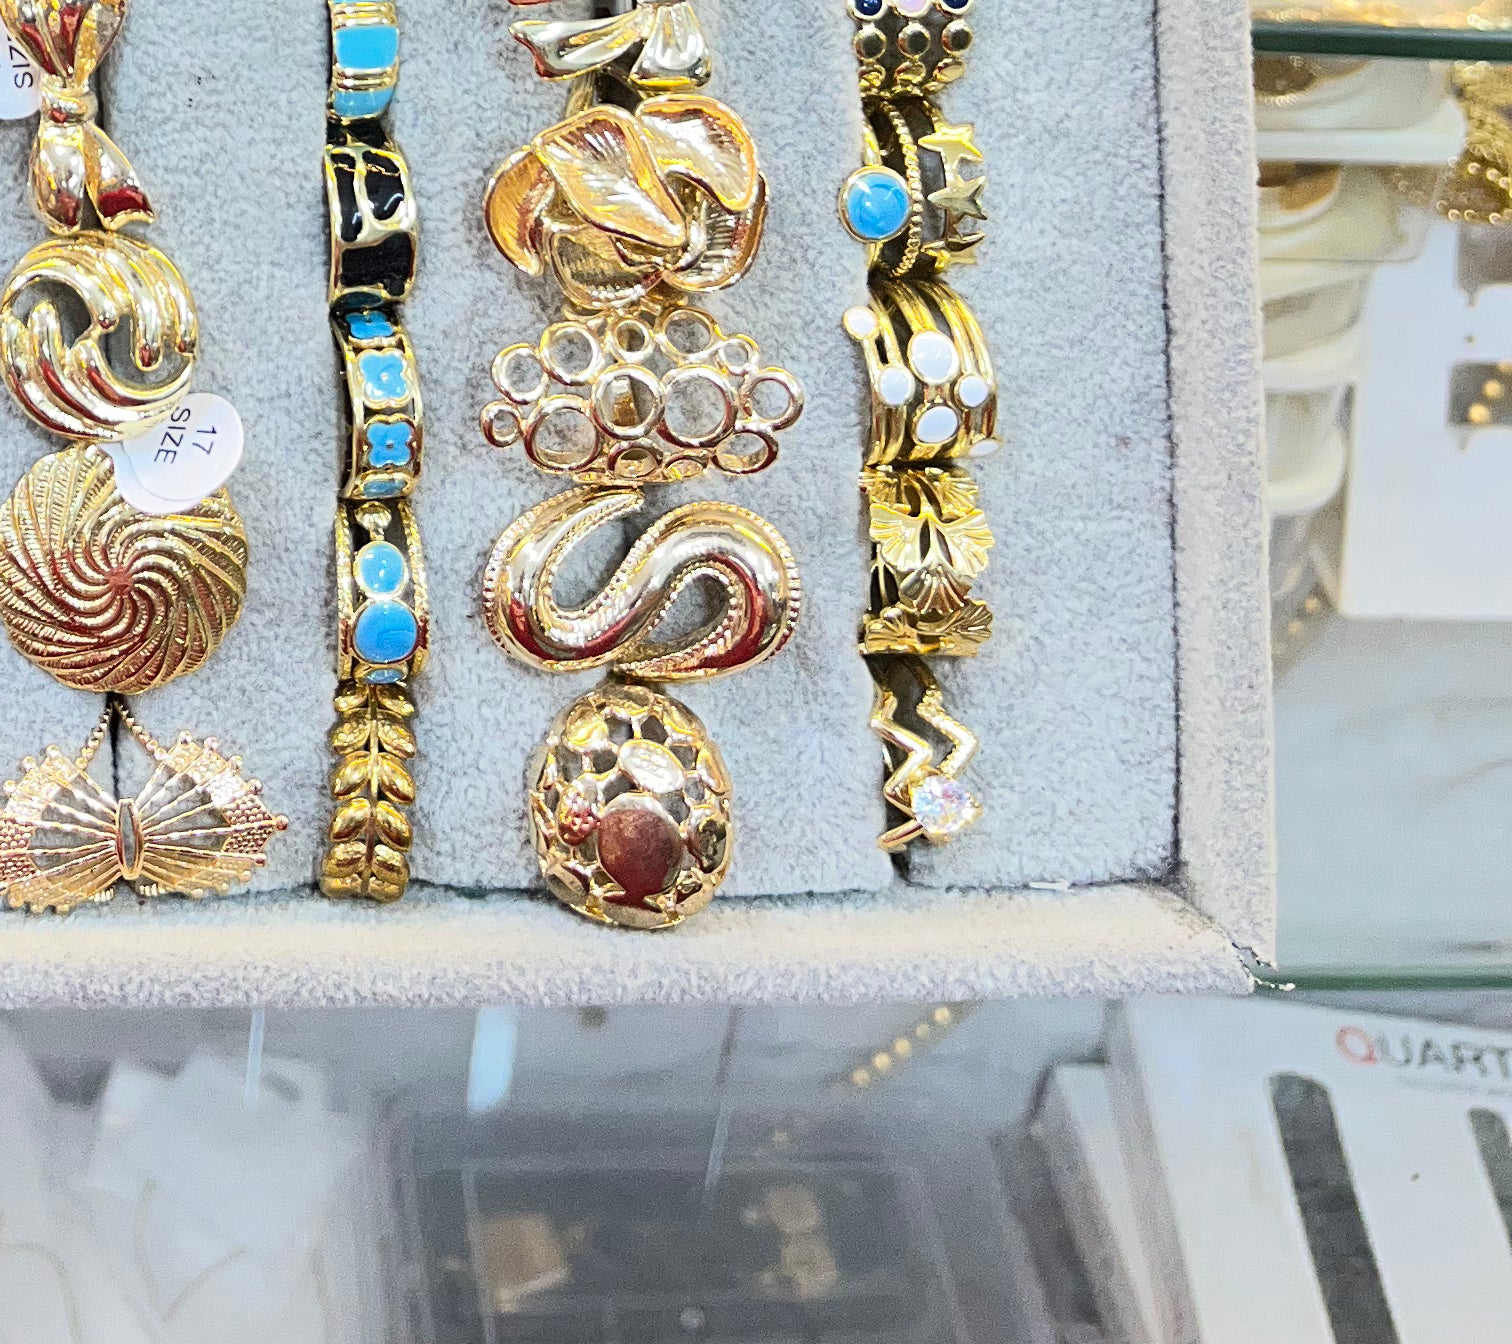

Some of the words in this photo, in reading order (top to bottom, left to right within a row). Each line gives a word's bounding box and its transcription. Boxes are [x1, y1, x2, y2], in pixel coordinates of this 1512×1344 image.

[7, 34, 34, 89] SIZ
[154, 406, 191, 464] SIZE
[192, 425, 217, 455] 17
